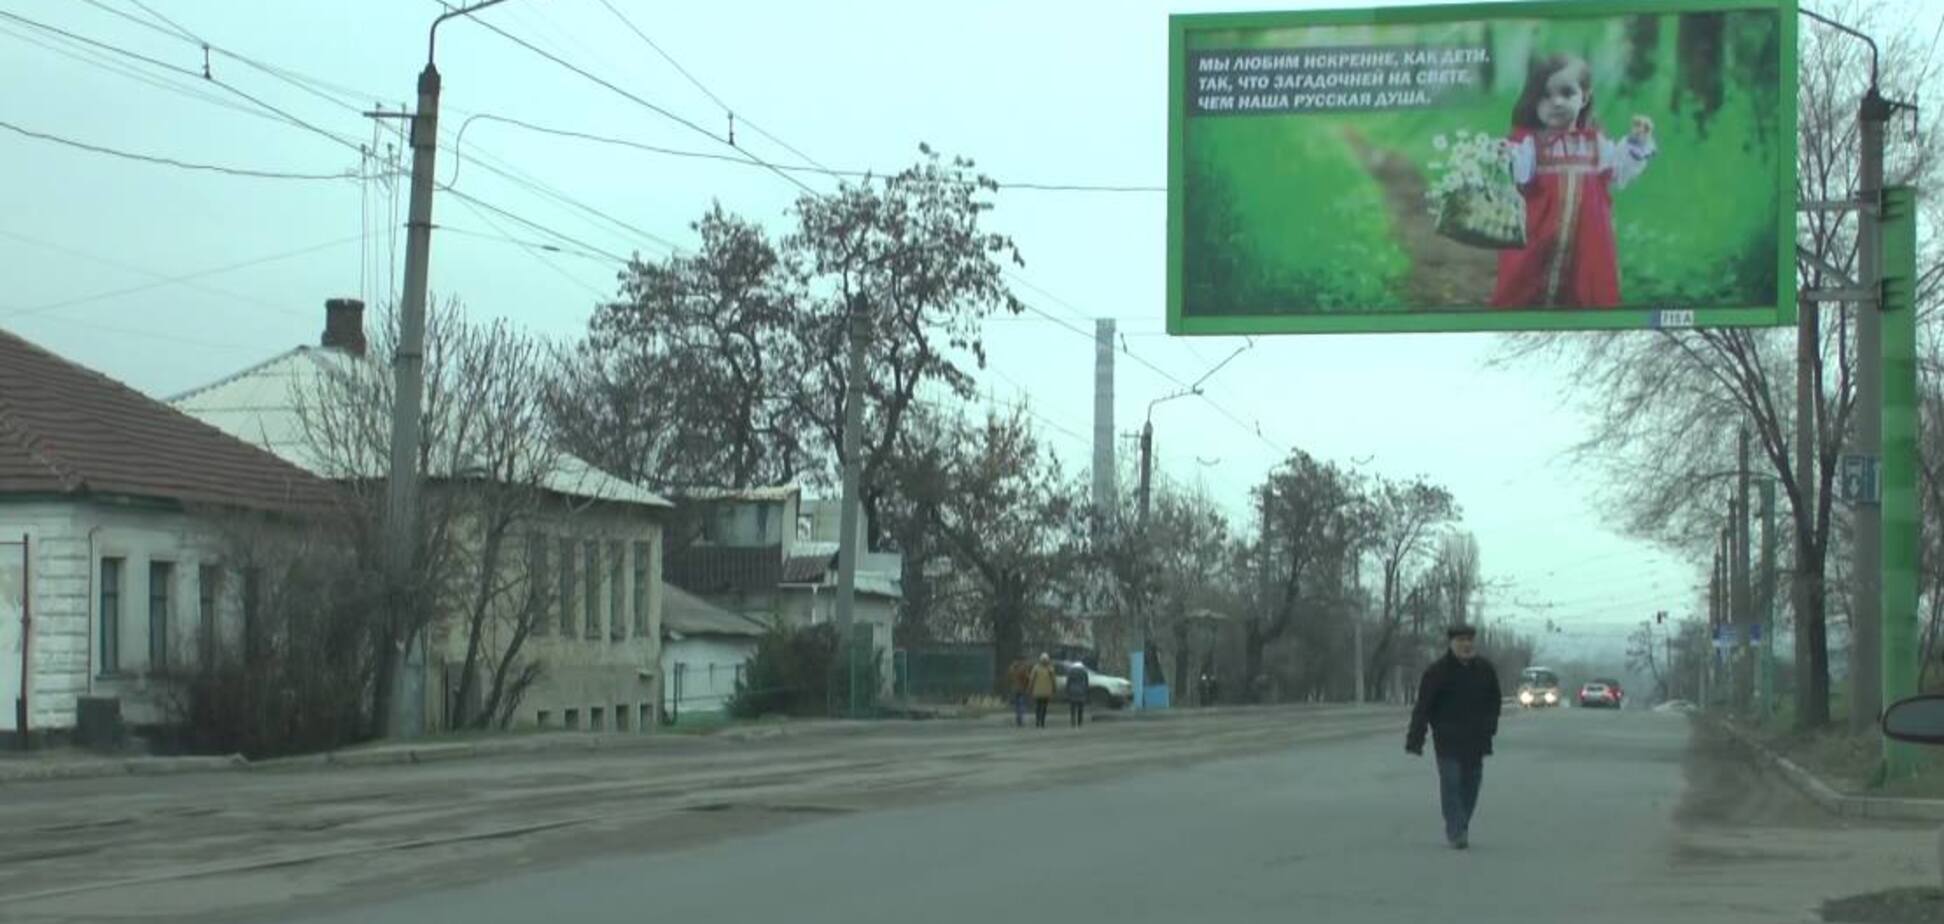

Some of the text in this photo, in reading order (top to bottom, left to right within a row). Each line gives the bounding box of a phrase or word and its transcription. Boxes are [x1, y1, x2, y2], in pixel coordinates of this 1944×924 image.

[1199, 57, 1230, 71] МЫ
[1233, 54, 1299, 70] ЛЮБИМ
[1303, 51, 1399, 69] ИСКРЕННЕ,
[1404, 51, 1437, 65] КАК
[1199, 76, 1233, 92] ТАК,
[1238, 75, 1269, 89] ЧТО
[1273, 70, 1384, 89] ЗАГАДОЧНЕЙ
[1388, 72, 1411, 86] НА
[1198, 90, 1431, 110] ЧЕМ НАША РУССКАЯ ДУША.
